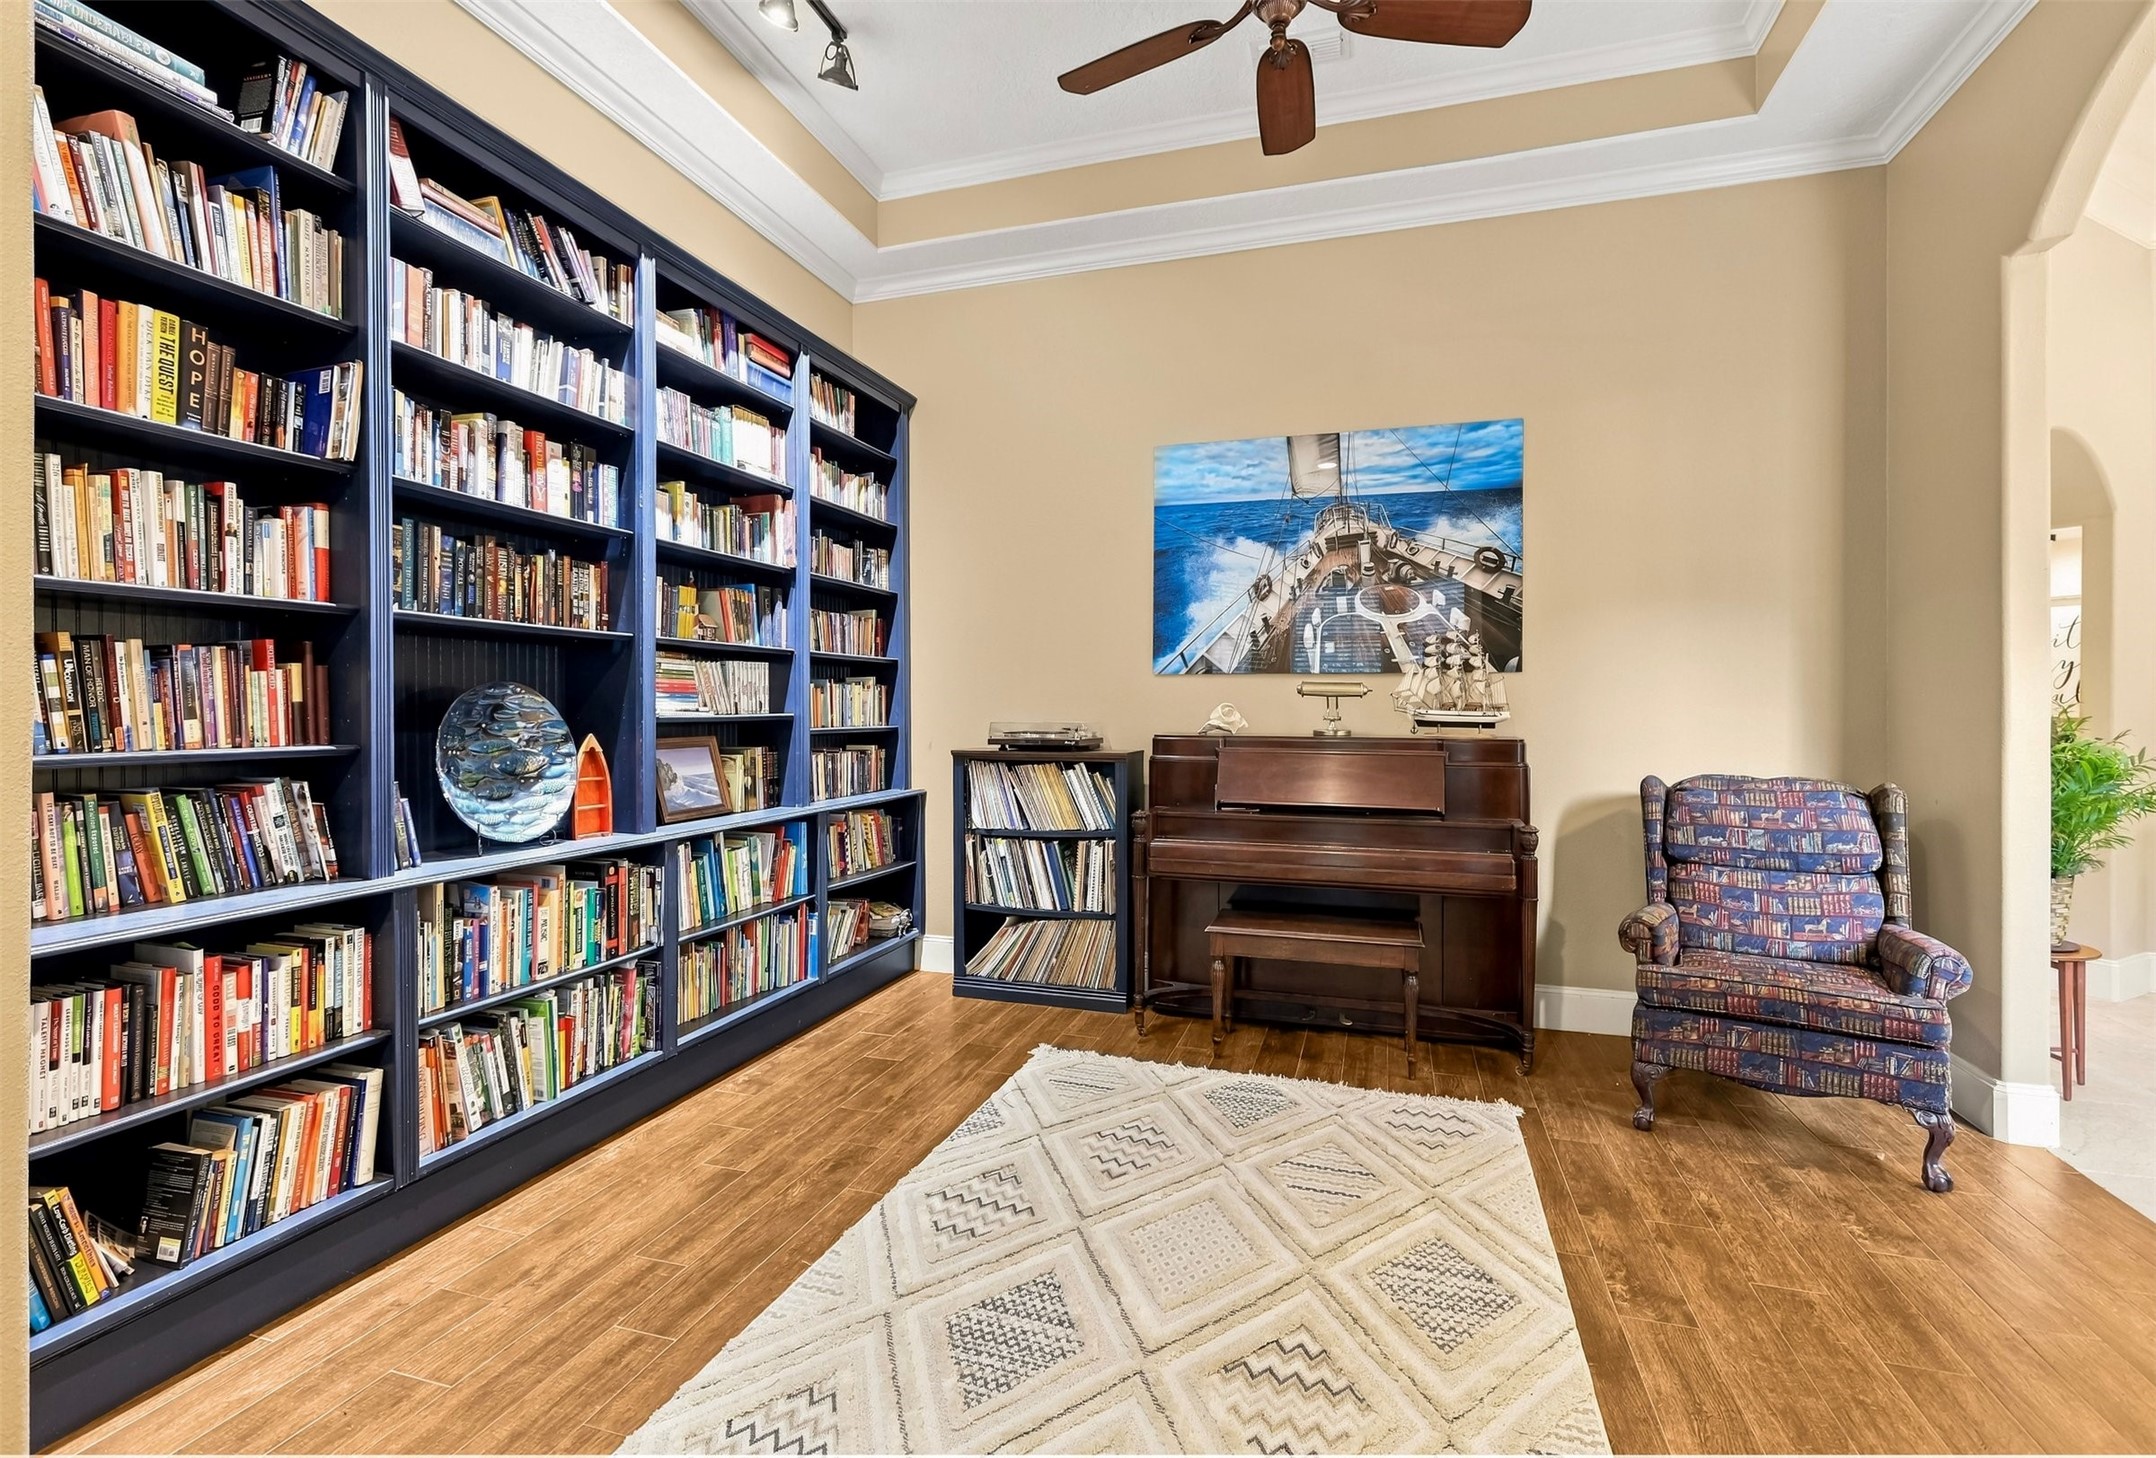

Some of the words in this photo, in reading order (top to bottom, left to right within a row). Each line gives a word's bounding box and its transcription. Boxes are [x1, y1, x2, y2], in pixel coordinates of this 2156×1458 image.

[168, 318, 176, 336] DANIEL
[159, 336, 175, 357] THE
[158, 357, 174, 394] QUEST
[190, 327, 206, 408] HOPE
[536, 435, 545, 487] BRADBURY
[497, 550, 507, 579] ILLUSION
[2051, 615, 2081, 649] it
[82, 645, 91, 665] MAN
[63, 658, 76, 702] UNCOMMON
[85, 665, 93, 676] OF
[2051, 660, 2080, 690] y
[86, 678, 96, 708] HONOR
[96, 677, 104, 702] HEROIC
[47, 814, 55, 827] OKAY
[88, 801, 97, 829] Evolution
[246, 804, 258, 831] COUNTER
[50, 840, 56, 848] TO
[90, 829, 99, 855] Exposed
[131, 832, 144, 855] TODAY
[444, 931, 452, 957] BIRDS
[540, 919, 548, 943] MUSIC
[212, 985, 220, 1011] GOOD
[40, 1017, 48, 1046] TALENT
[213, 1015, 220, 1028] TO
[226, 1035, 236, 1047] LAST
[214, 1180, 222, 1196] Leader
[53, 1205, 68, 1234] Low-Carb
[63, 1234, 77, 1257] Dieting
[75, 1261, 92, 1294] DUMMIES
